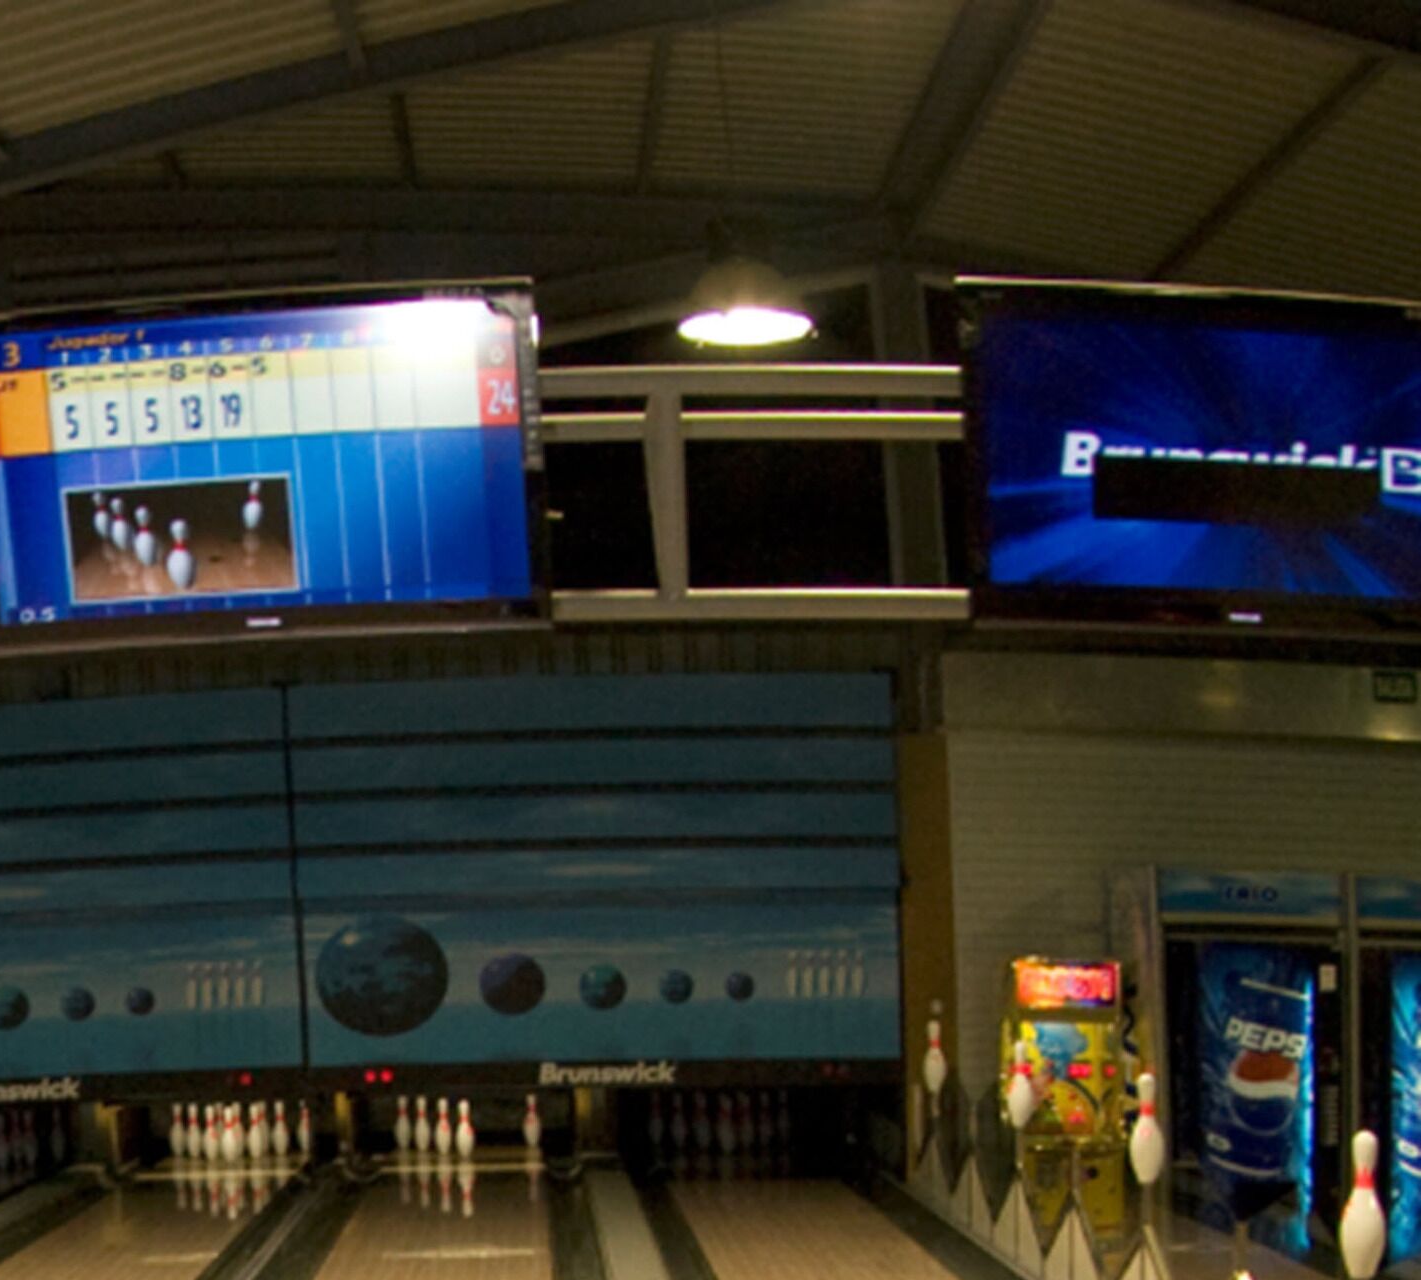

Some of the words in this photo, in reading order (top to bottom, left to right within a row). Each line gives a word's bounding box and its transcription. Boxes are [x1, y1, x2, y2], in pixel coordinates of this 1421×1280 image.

[3, 342, 21, 367] 3
[65, 405, 80, 440] 5
[104, 401, 119, 436] 5
[144, 398, 159, 433] 5
[181, 395, 203, 430] 13
[220, 393, 243, 428] 19
[487, 379, 516, 417] 24
[539, 1059, 677, 1085] Brunswick
